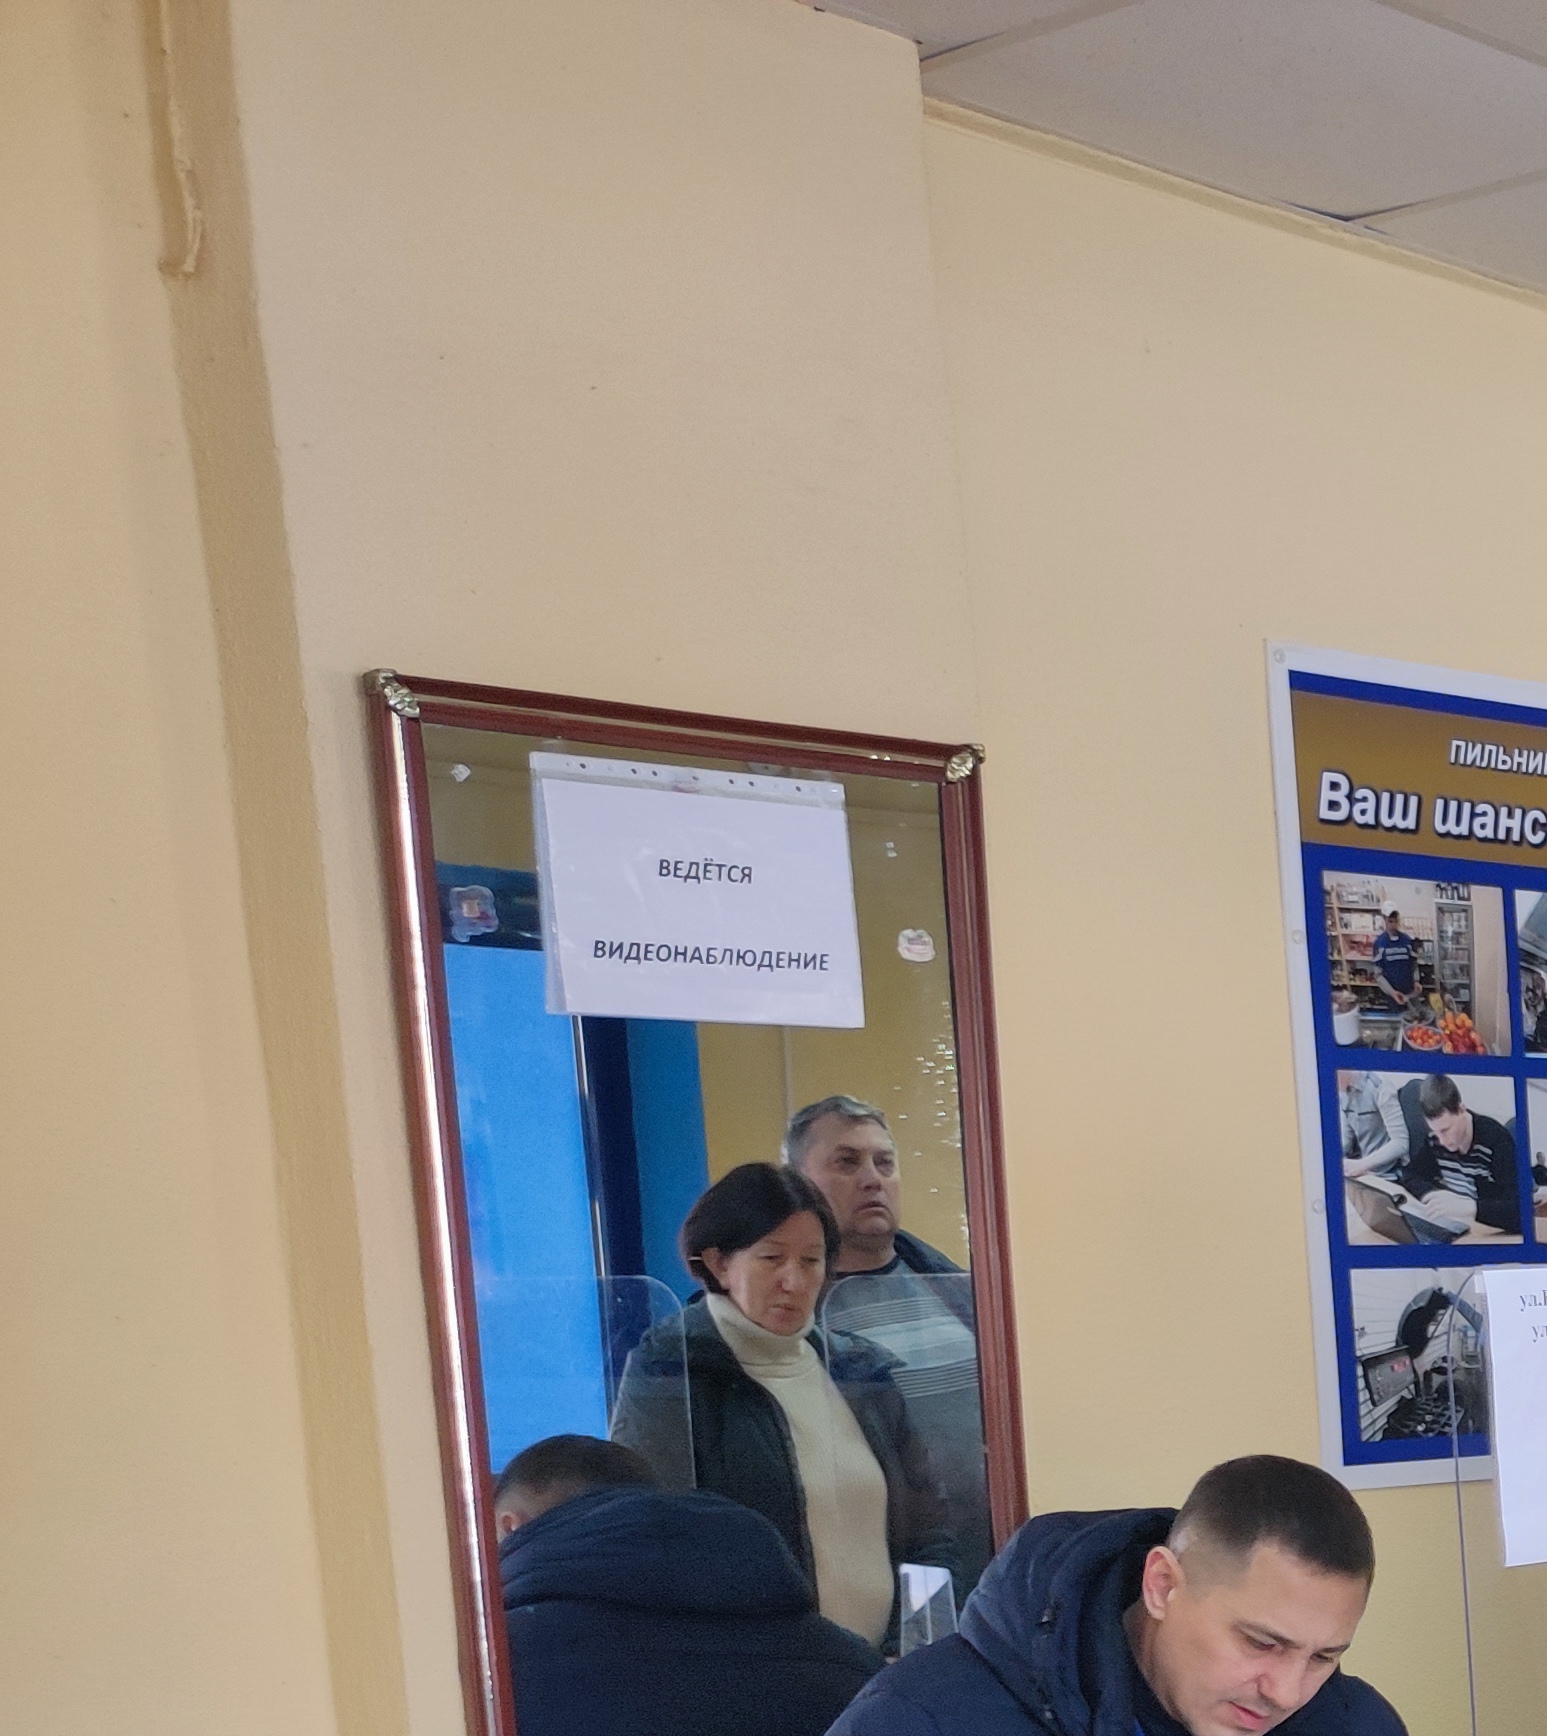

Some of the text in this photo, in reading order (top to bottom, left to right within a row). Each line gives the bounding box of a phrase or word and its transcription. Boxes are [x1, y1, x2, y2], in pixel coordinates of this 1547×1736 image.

[1318, 770, 1420, 831] Ваш
[658, 857, 753, 885] ВЕДЁТСЯ
[592, 940, 831, 973] ВИДЕОНАБЛЮДЕНИЕ
